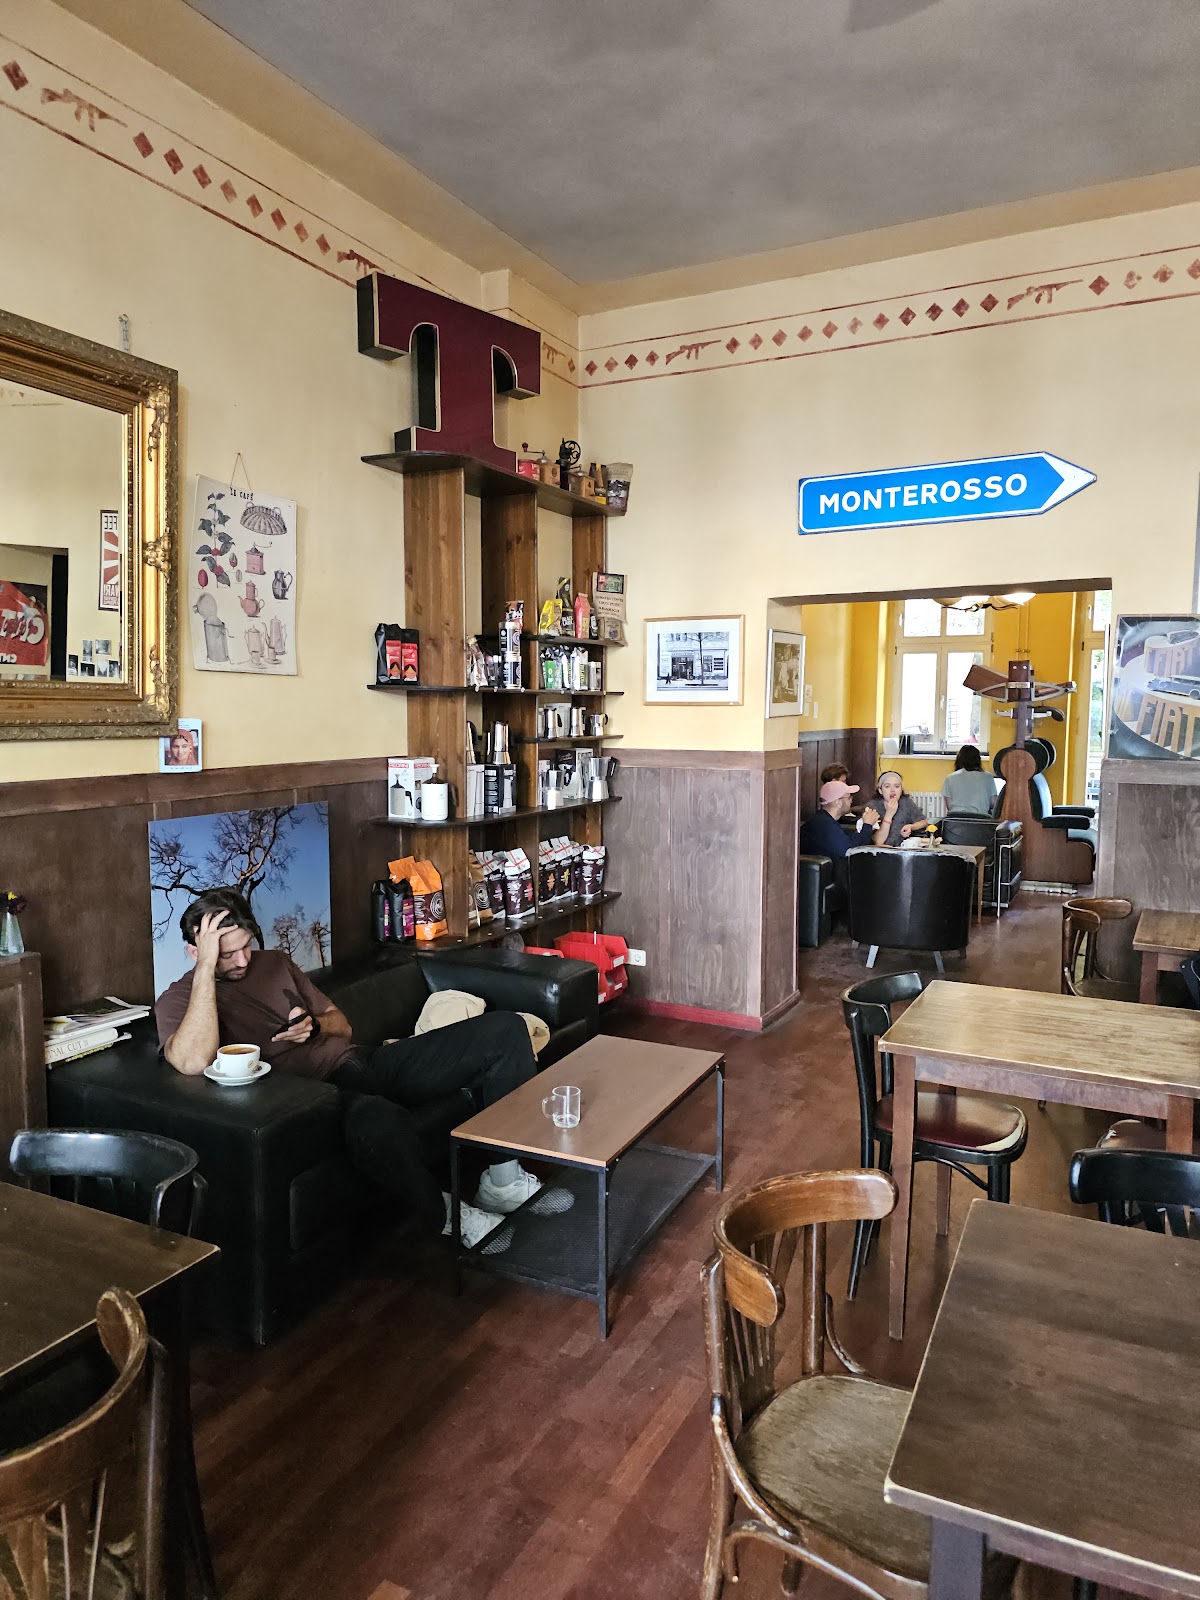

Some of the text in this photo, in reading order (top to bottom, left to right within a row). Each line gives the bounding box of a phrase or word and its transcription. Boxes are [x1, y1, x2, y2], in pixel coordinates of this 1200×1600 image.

[230, 486, 254, 501] LE CAFÉ
[818, 473, 1028, 515] MONTEROSSO
[1154, 645, 1194, 678] FIAT
[1136, 694, 1200, 758] FIAT
[67, 1040, 82, 1052] CUT
